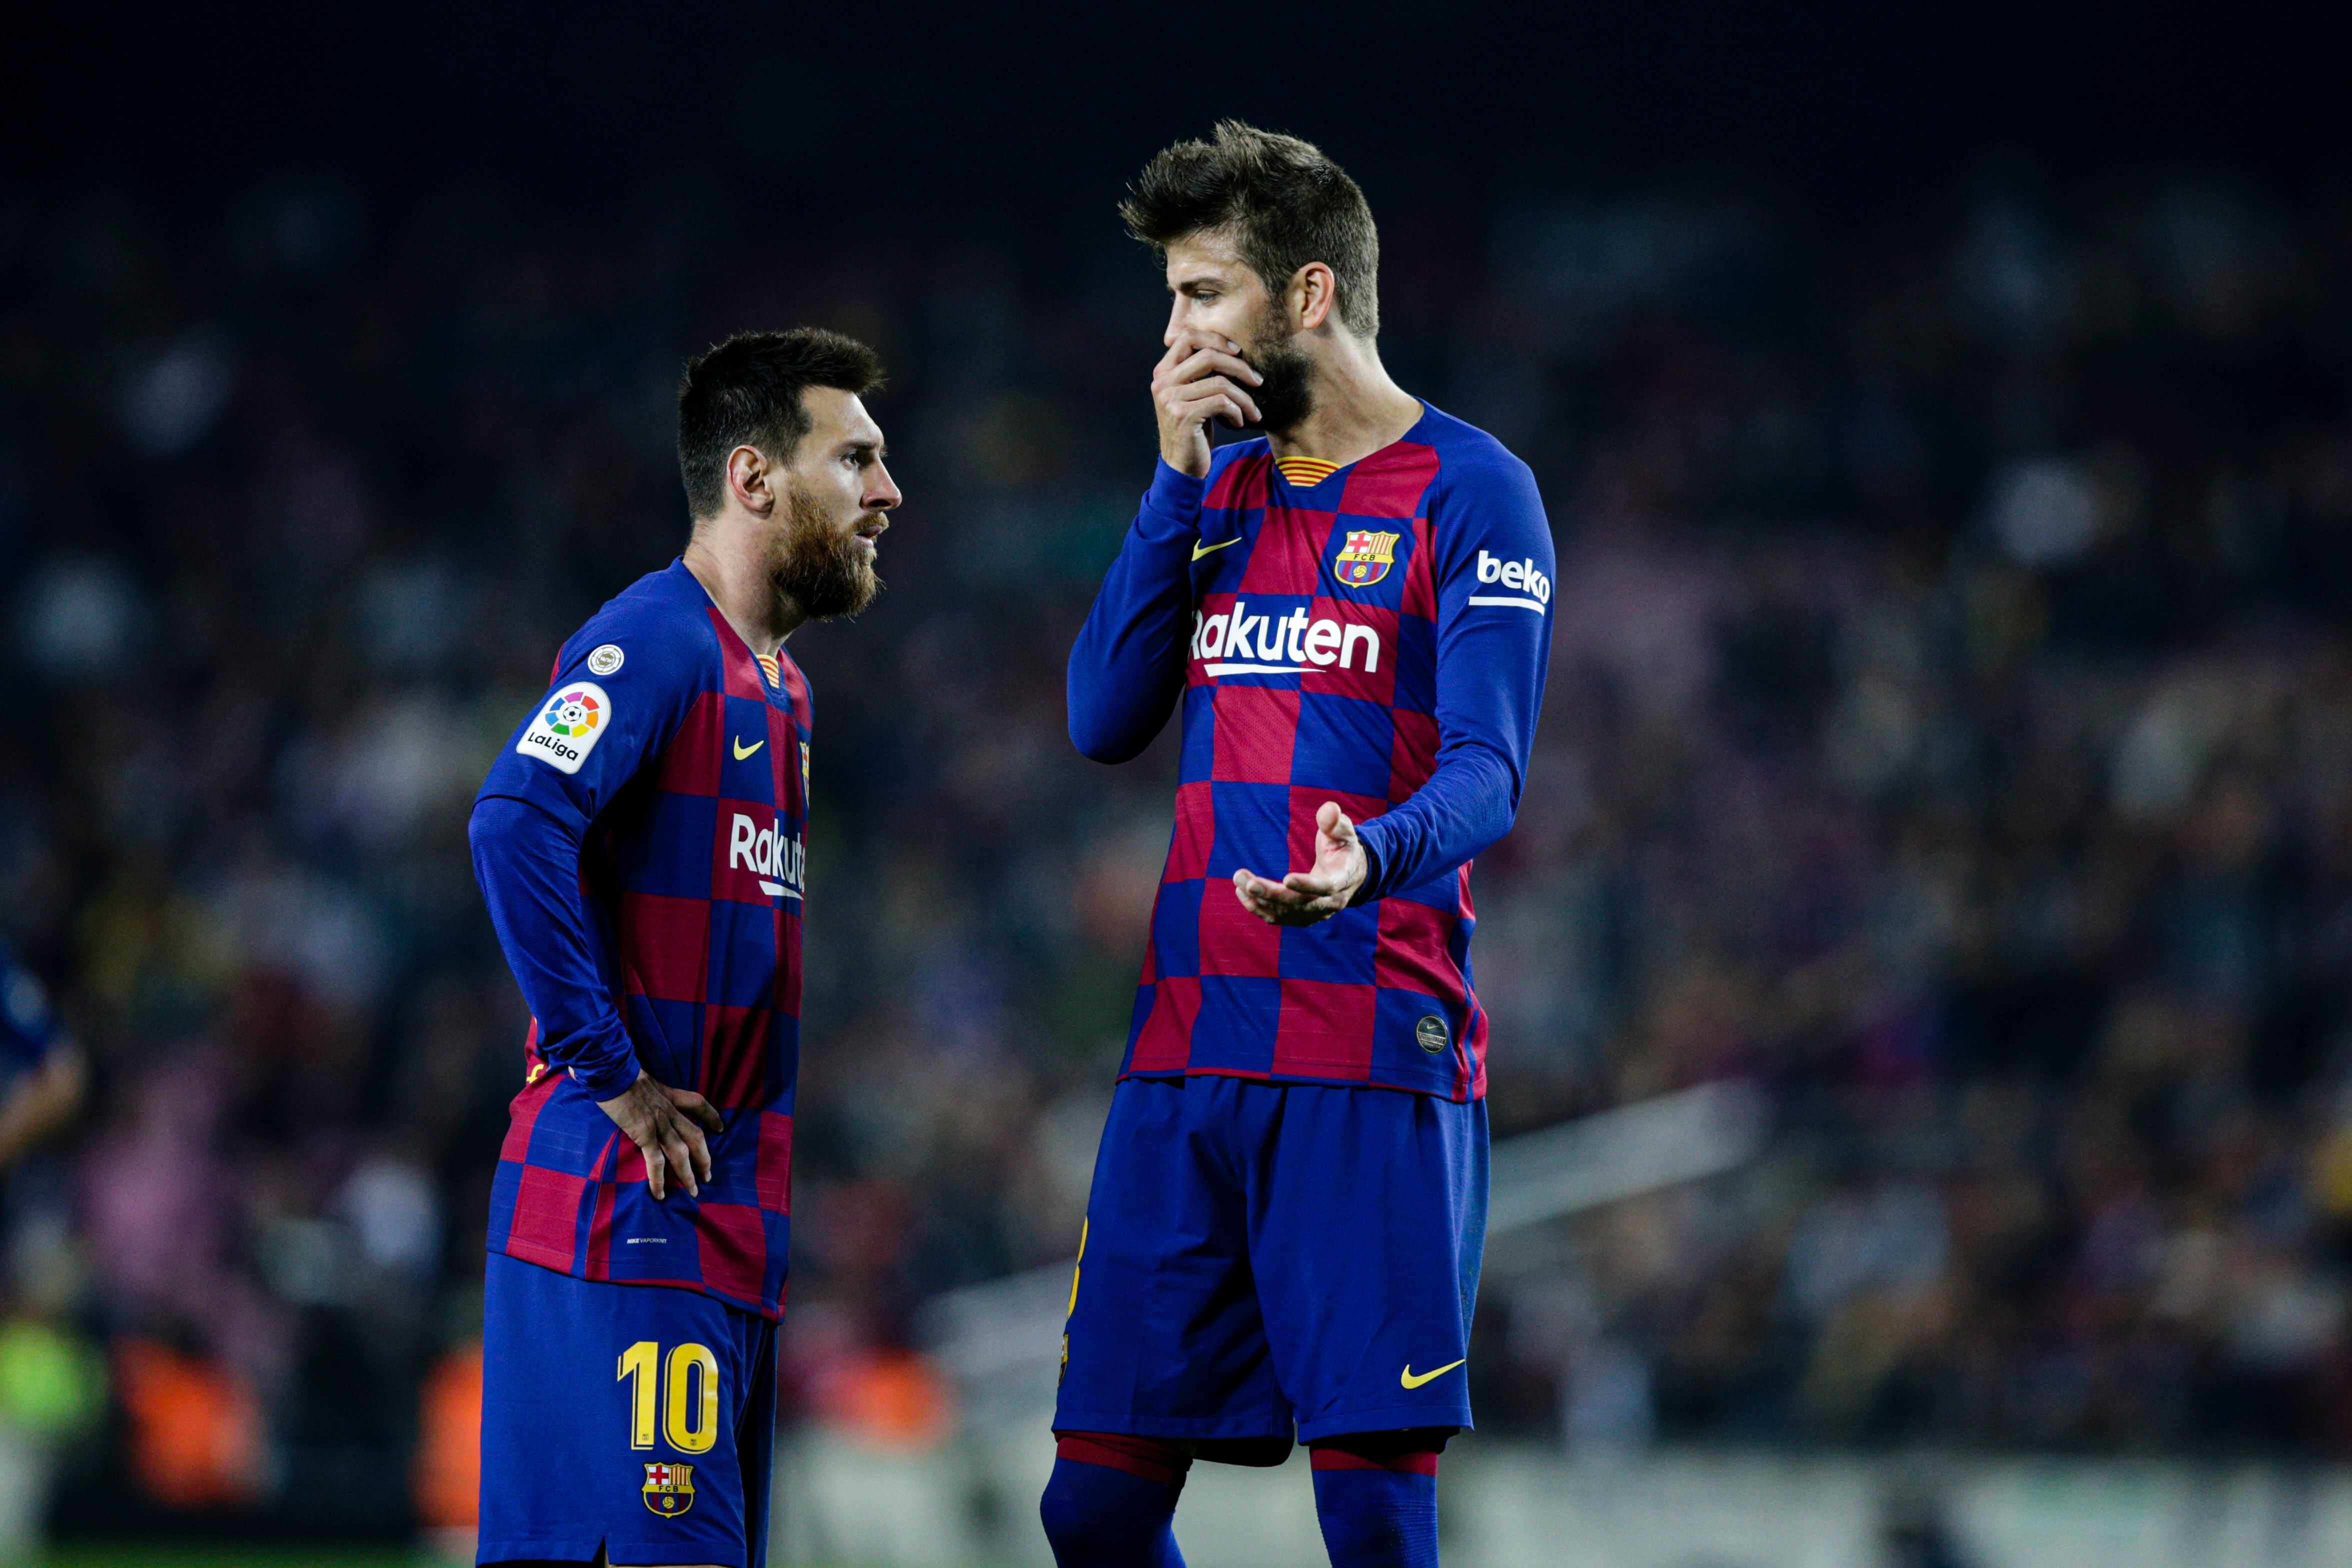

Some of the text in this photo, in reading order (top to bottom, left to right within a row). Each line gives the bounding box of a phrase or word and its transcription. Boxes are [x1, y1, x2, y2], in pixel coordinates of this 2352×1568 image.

[1478, 550, 1550, 604] beko
[528, 732, 578, 761] LaLiga
[617, 1341, 718, 1454] 10
